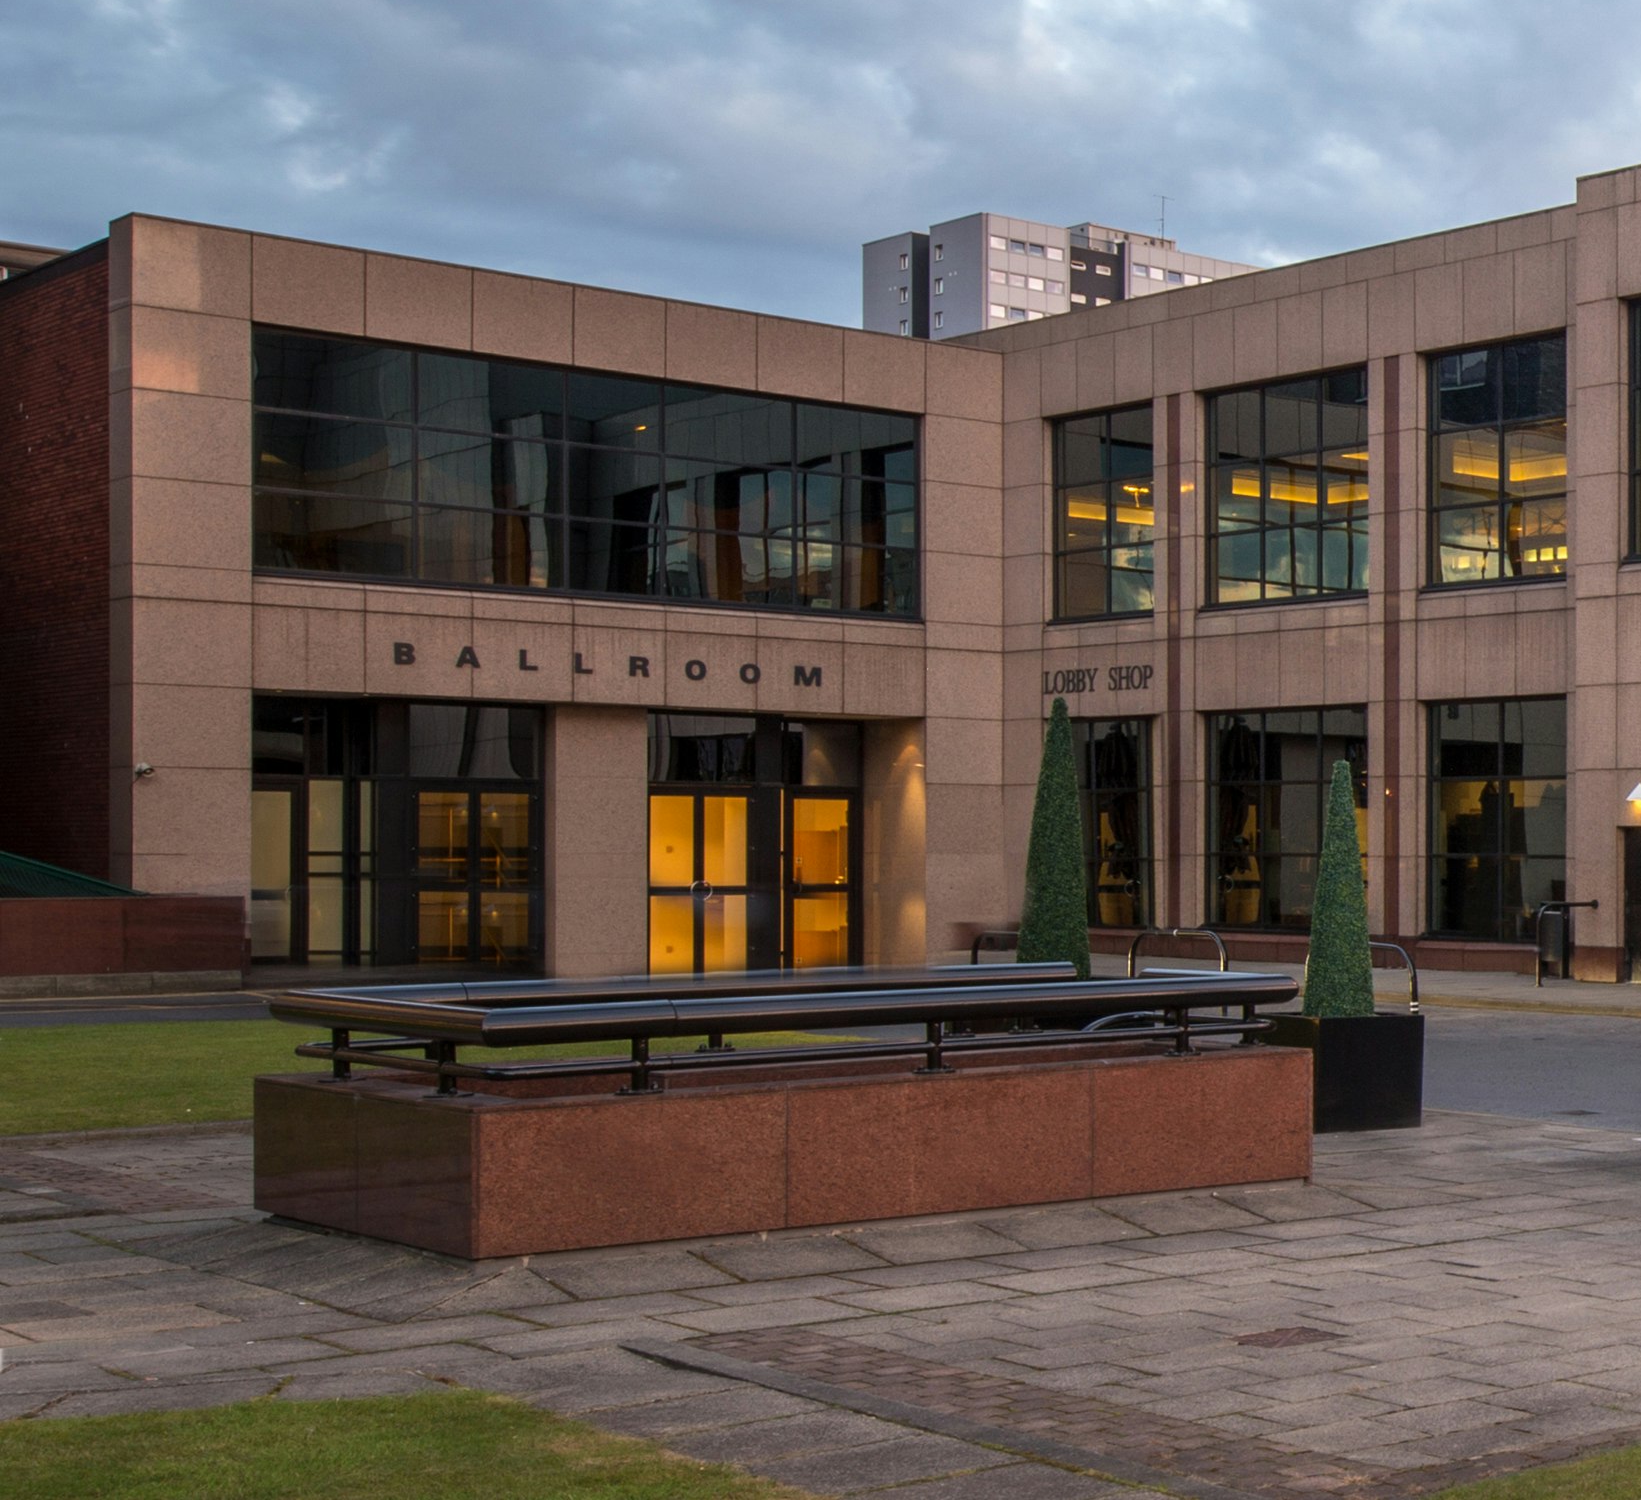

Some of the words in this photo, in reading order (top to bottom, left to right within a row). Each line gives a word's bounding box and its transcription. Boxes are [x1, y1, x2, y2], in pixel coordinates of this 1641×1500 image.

[393, 642, 823, 688] BALLROOM
[1043, 668, 1099, 695] LOBBY
[1107, 665, 1154, 691] SHOP
